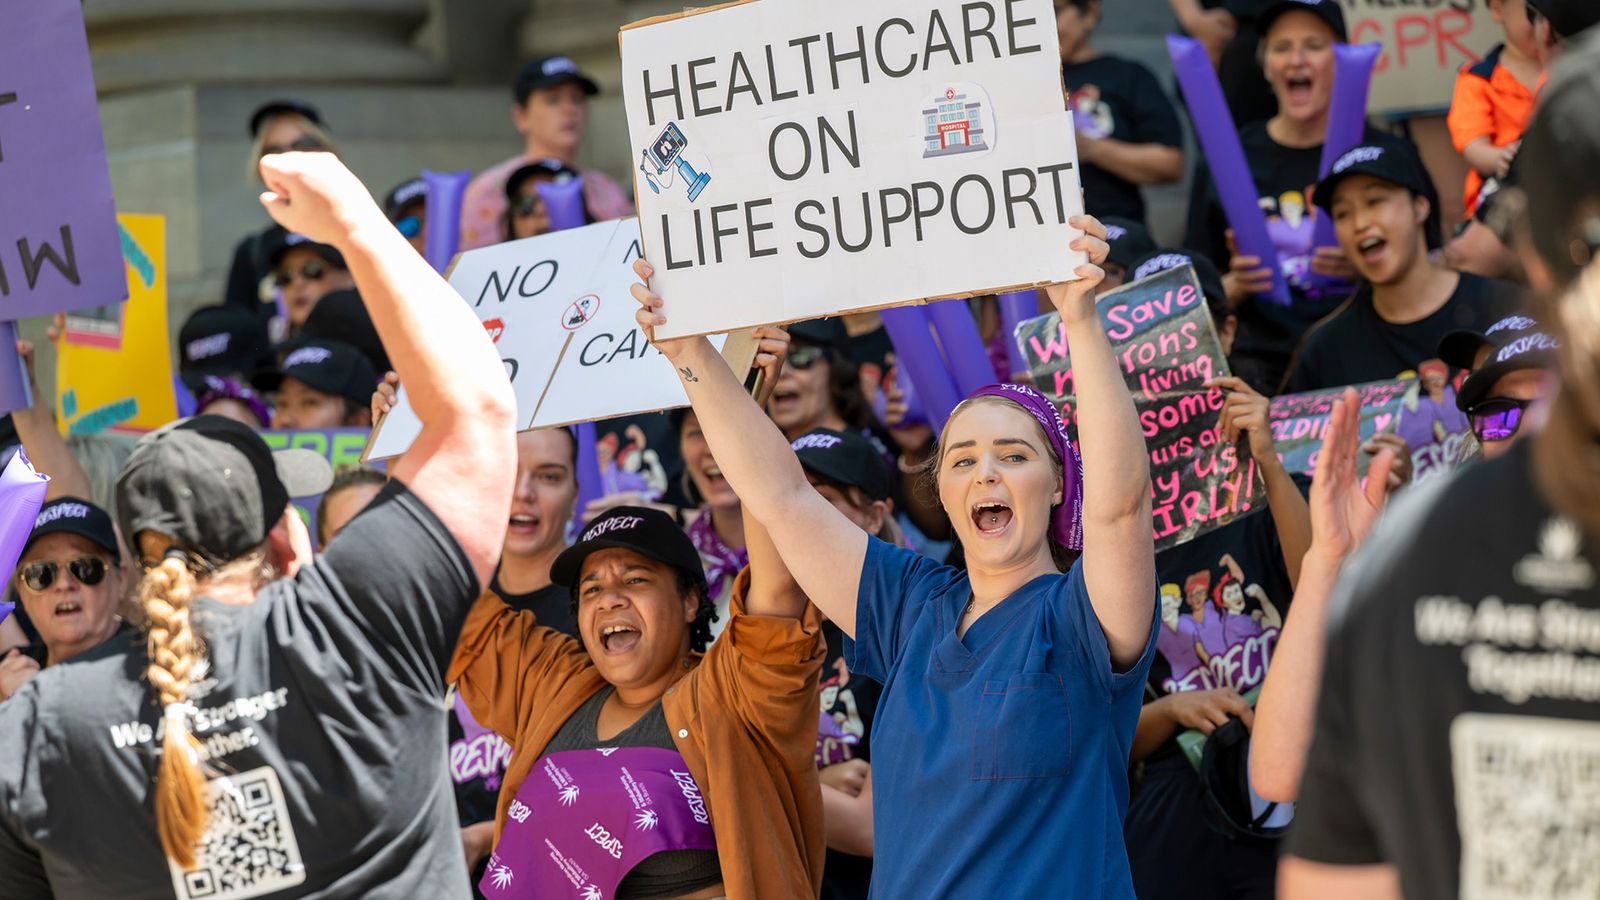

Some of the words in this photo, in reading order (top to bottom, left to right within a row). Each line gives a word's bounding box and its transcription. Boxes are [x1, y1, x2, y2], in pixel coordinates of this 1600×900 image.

[642, 0, 1041, 126] HEALTHCARE
[1350, 9, 1482, 77] CPR
[768, 110, 861, 181] ON
[661, 197, 778, 271] LIFE
[794, 162, 1074, 259] SUPPORT
[475, 259, 559, 307] NO
[1106, 284, 1197, 340] Save
[1139, 354, 1213, 400] living
[1193, 446, 1239, 478] us
[1152, 458, 1255, 540] IRLY!
[582, 515, 645, 543] RESPECT
[110, 721, 153, 748] We
[670, 768, 709, 825] RESPECT
[584, 822, 624, 860] ESPECT
